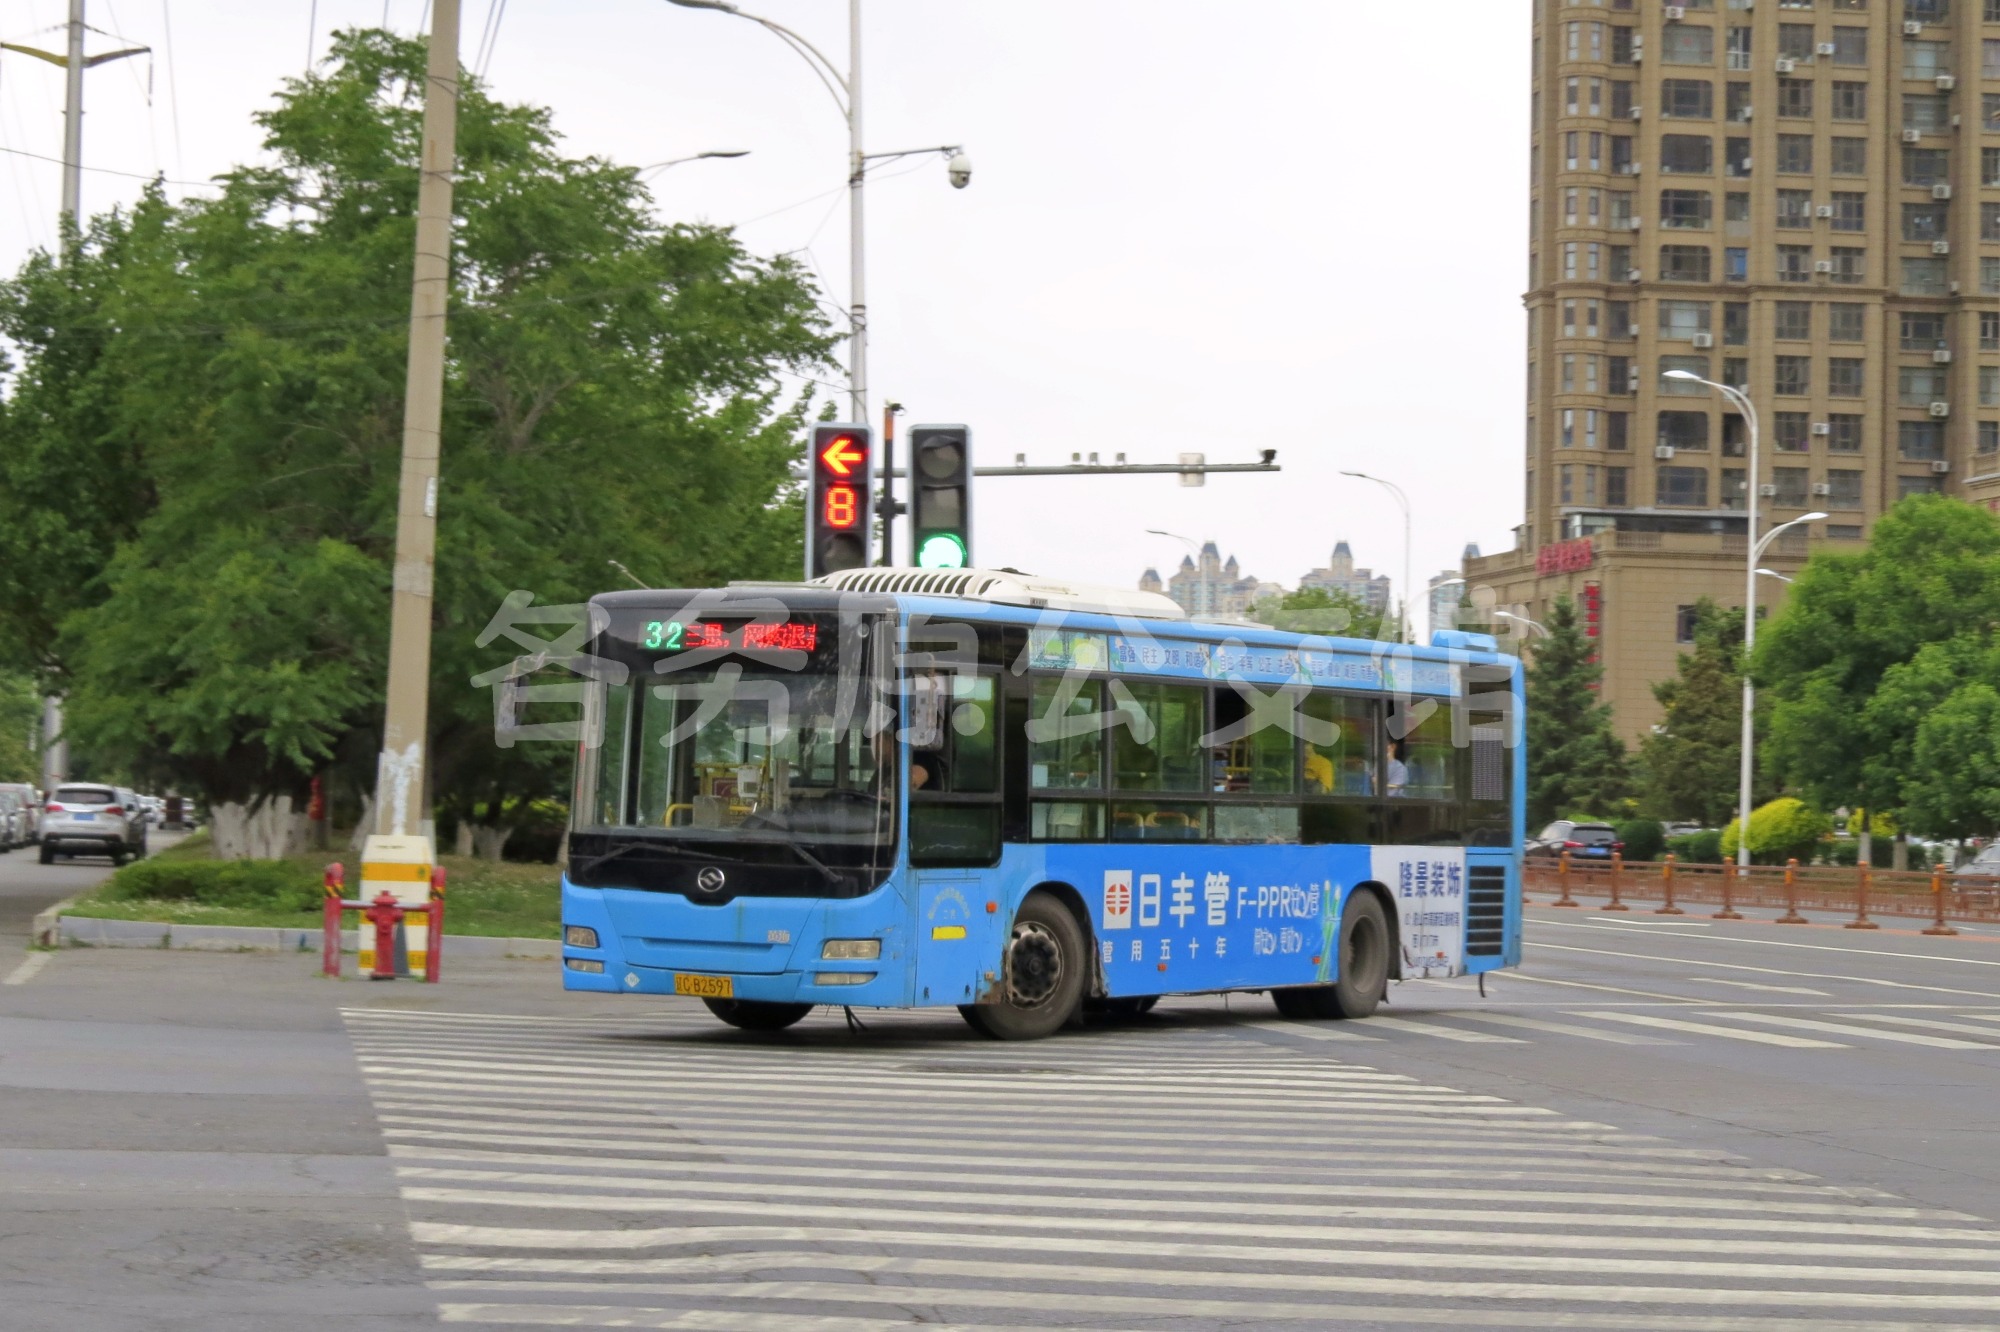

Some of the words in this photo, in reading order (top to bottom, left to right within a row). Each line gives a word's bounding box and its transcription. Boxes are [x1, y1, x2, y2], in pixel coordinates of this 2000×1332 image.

[827, 487, 855, 526] 8
[645, 621, 682, 649] 32
[1142, 647, 1158, 664] 民主
[1164, 648, 1180, 666] 文明
[1139, 870, 1231, 928] 日丰管
